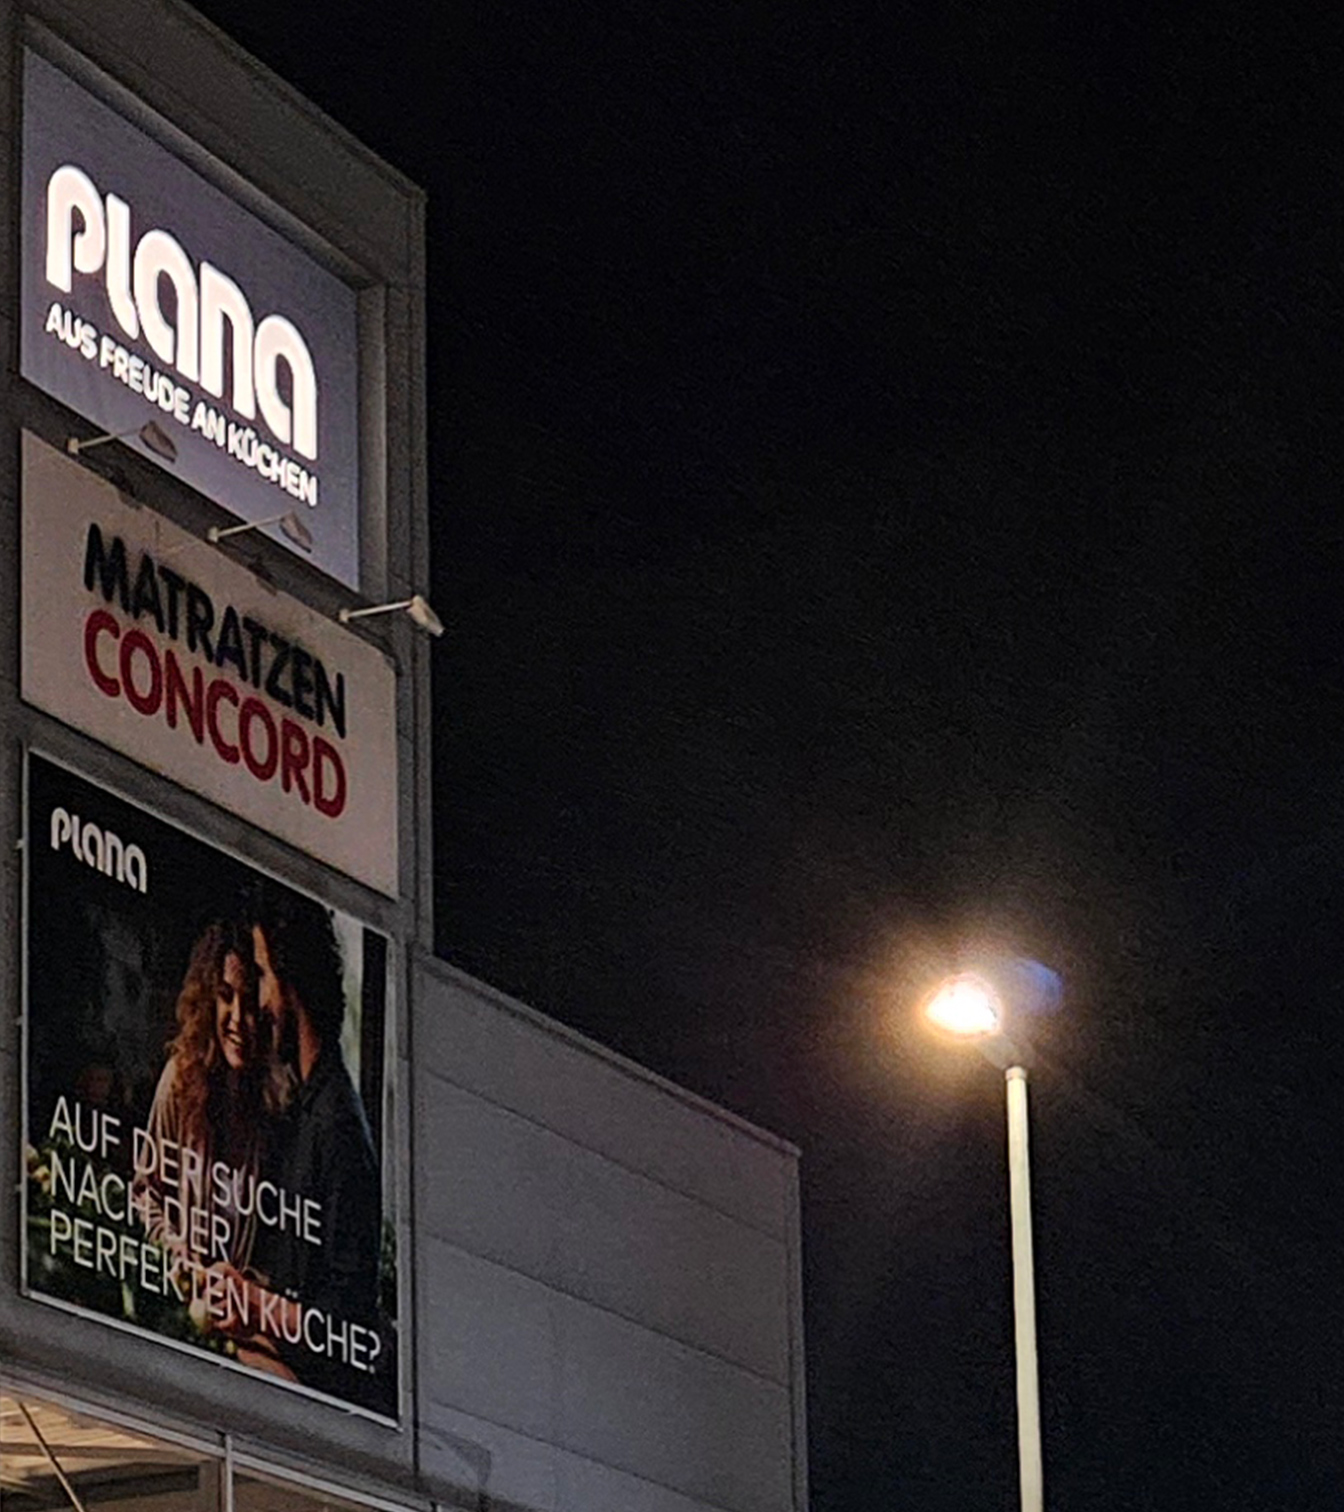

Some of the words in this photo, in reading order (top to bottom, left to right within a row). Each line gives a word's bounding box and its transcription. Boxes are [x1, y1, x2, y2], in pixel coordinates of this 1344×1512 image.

[45, 302, 98, 360] AUS
[99, 335, 191, 425] FREUDE
[191, 401, 226, 447] AN
[227, 422, 318, 507] KÜCHEN
[83, 522, 347, 740] MATRATZEN
[83, 607, 347, 819] CONCORD
[49, 1095, 120, 1159] AUF
[132, 1127, 203, 1198] DER
[211, 1160, 322, 1246] SUCHE
[50, 1150, 152, 1234] NACH
[163, 1195, 233, 1263] DER
[50, 1208, 249, 1327] PERFEKTEN
[260, 1287, 381, 1374] KÜCHE?
